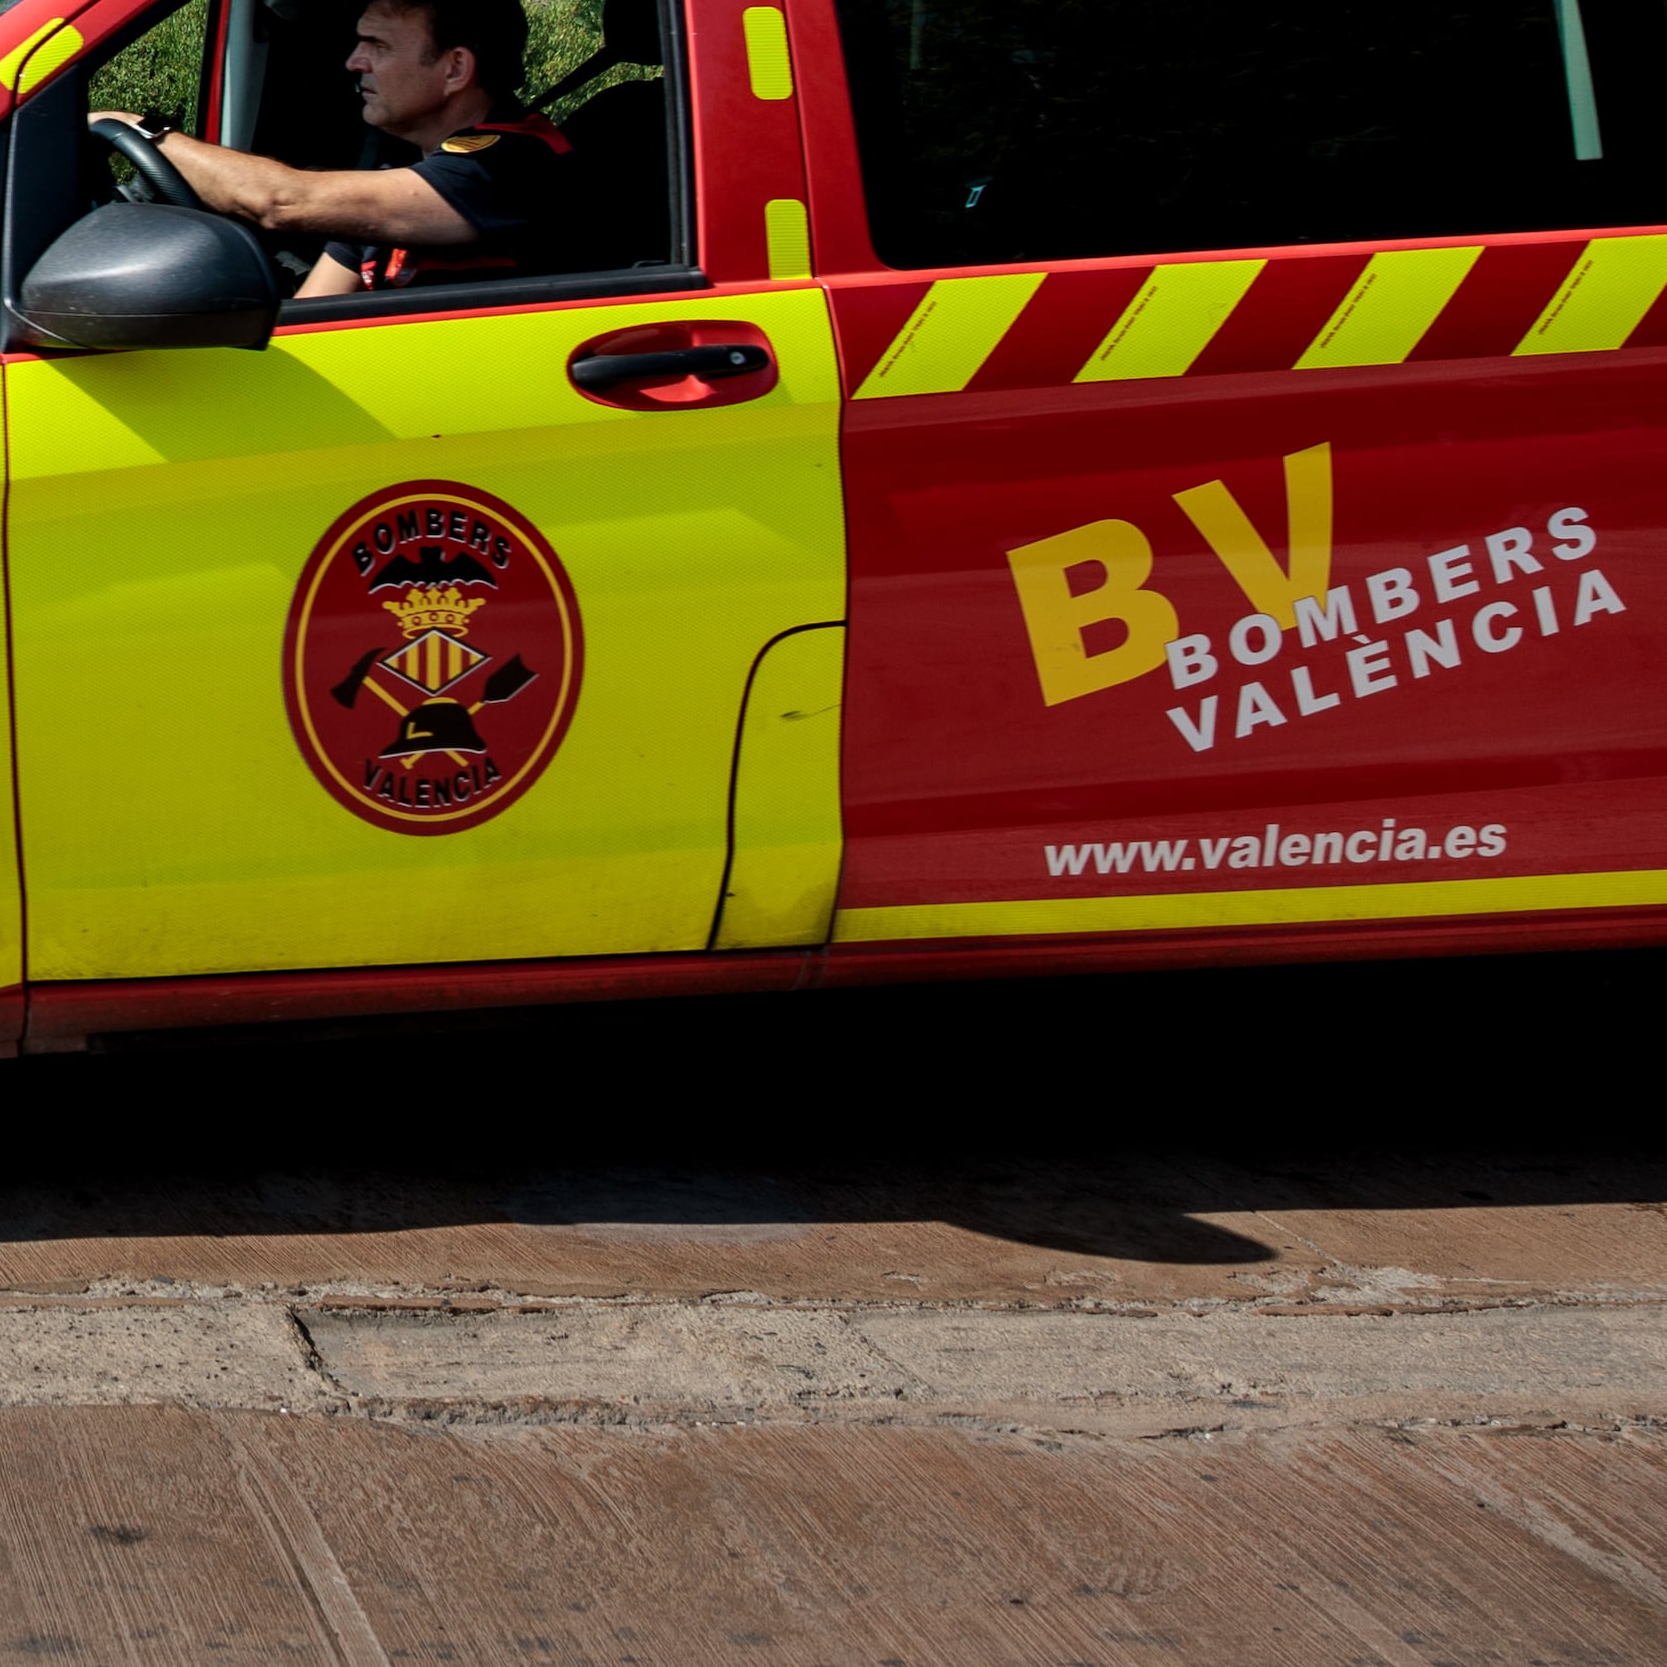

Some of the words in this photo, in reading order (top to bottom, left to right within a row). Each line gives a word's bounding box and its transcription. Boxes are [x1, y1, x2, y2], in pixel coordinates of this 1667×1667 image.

[352, 508, 512, 576] BOMBERS
[1006, 441, 1333, 707] BV
[1163, 507, 1597, 690] BOMBERS
[1165, 568, 1627, 753] VALÈNCIA
[363, 756, 502, 808] VALENCIA
[1044, 818, 1508, 877] www.valencia.es
